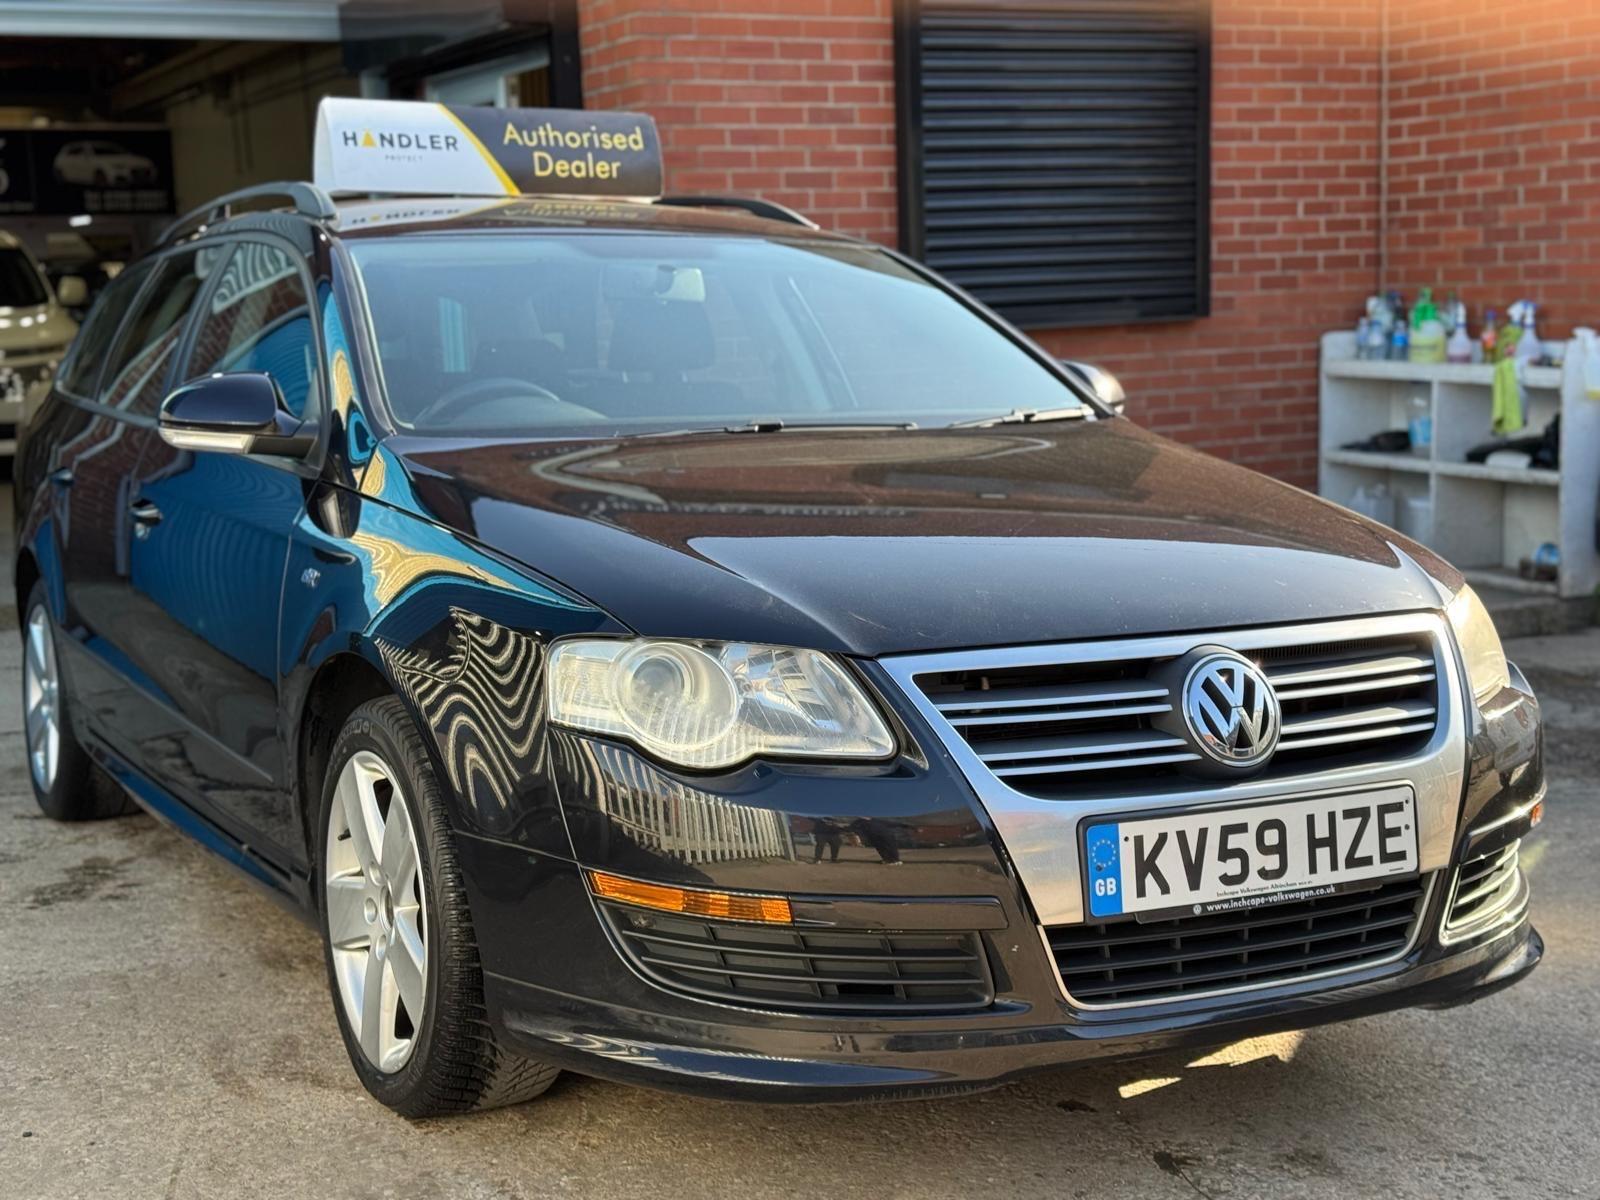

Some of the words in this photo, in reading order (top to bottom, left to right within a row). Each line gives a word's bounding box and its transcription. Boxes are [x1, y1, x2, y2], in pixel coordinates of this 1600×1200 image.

[342, 129, 458, 151] HANDLER
[503, 122, 644, 152] Authorised
[534, 152, 622, 179] Dealer
[1132, 818, 1288, 899] KV59
[1306, 801, 1408, 875] HZE
[1095, 877, 1117, 897] GB
[1206, 884, 1336, 912] www.inchcape-volkswagen.co.uk
